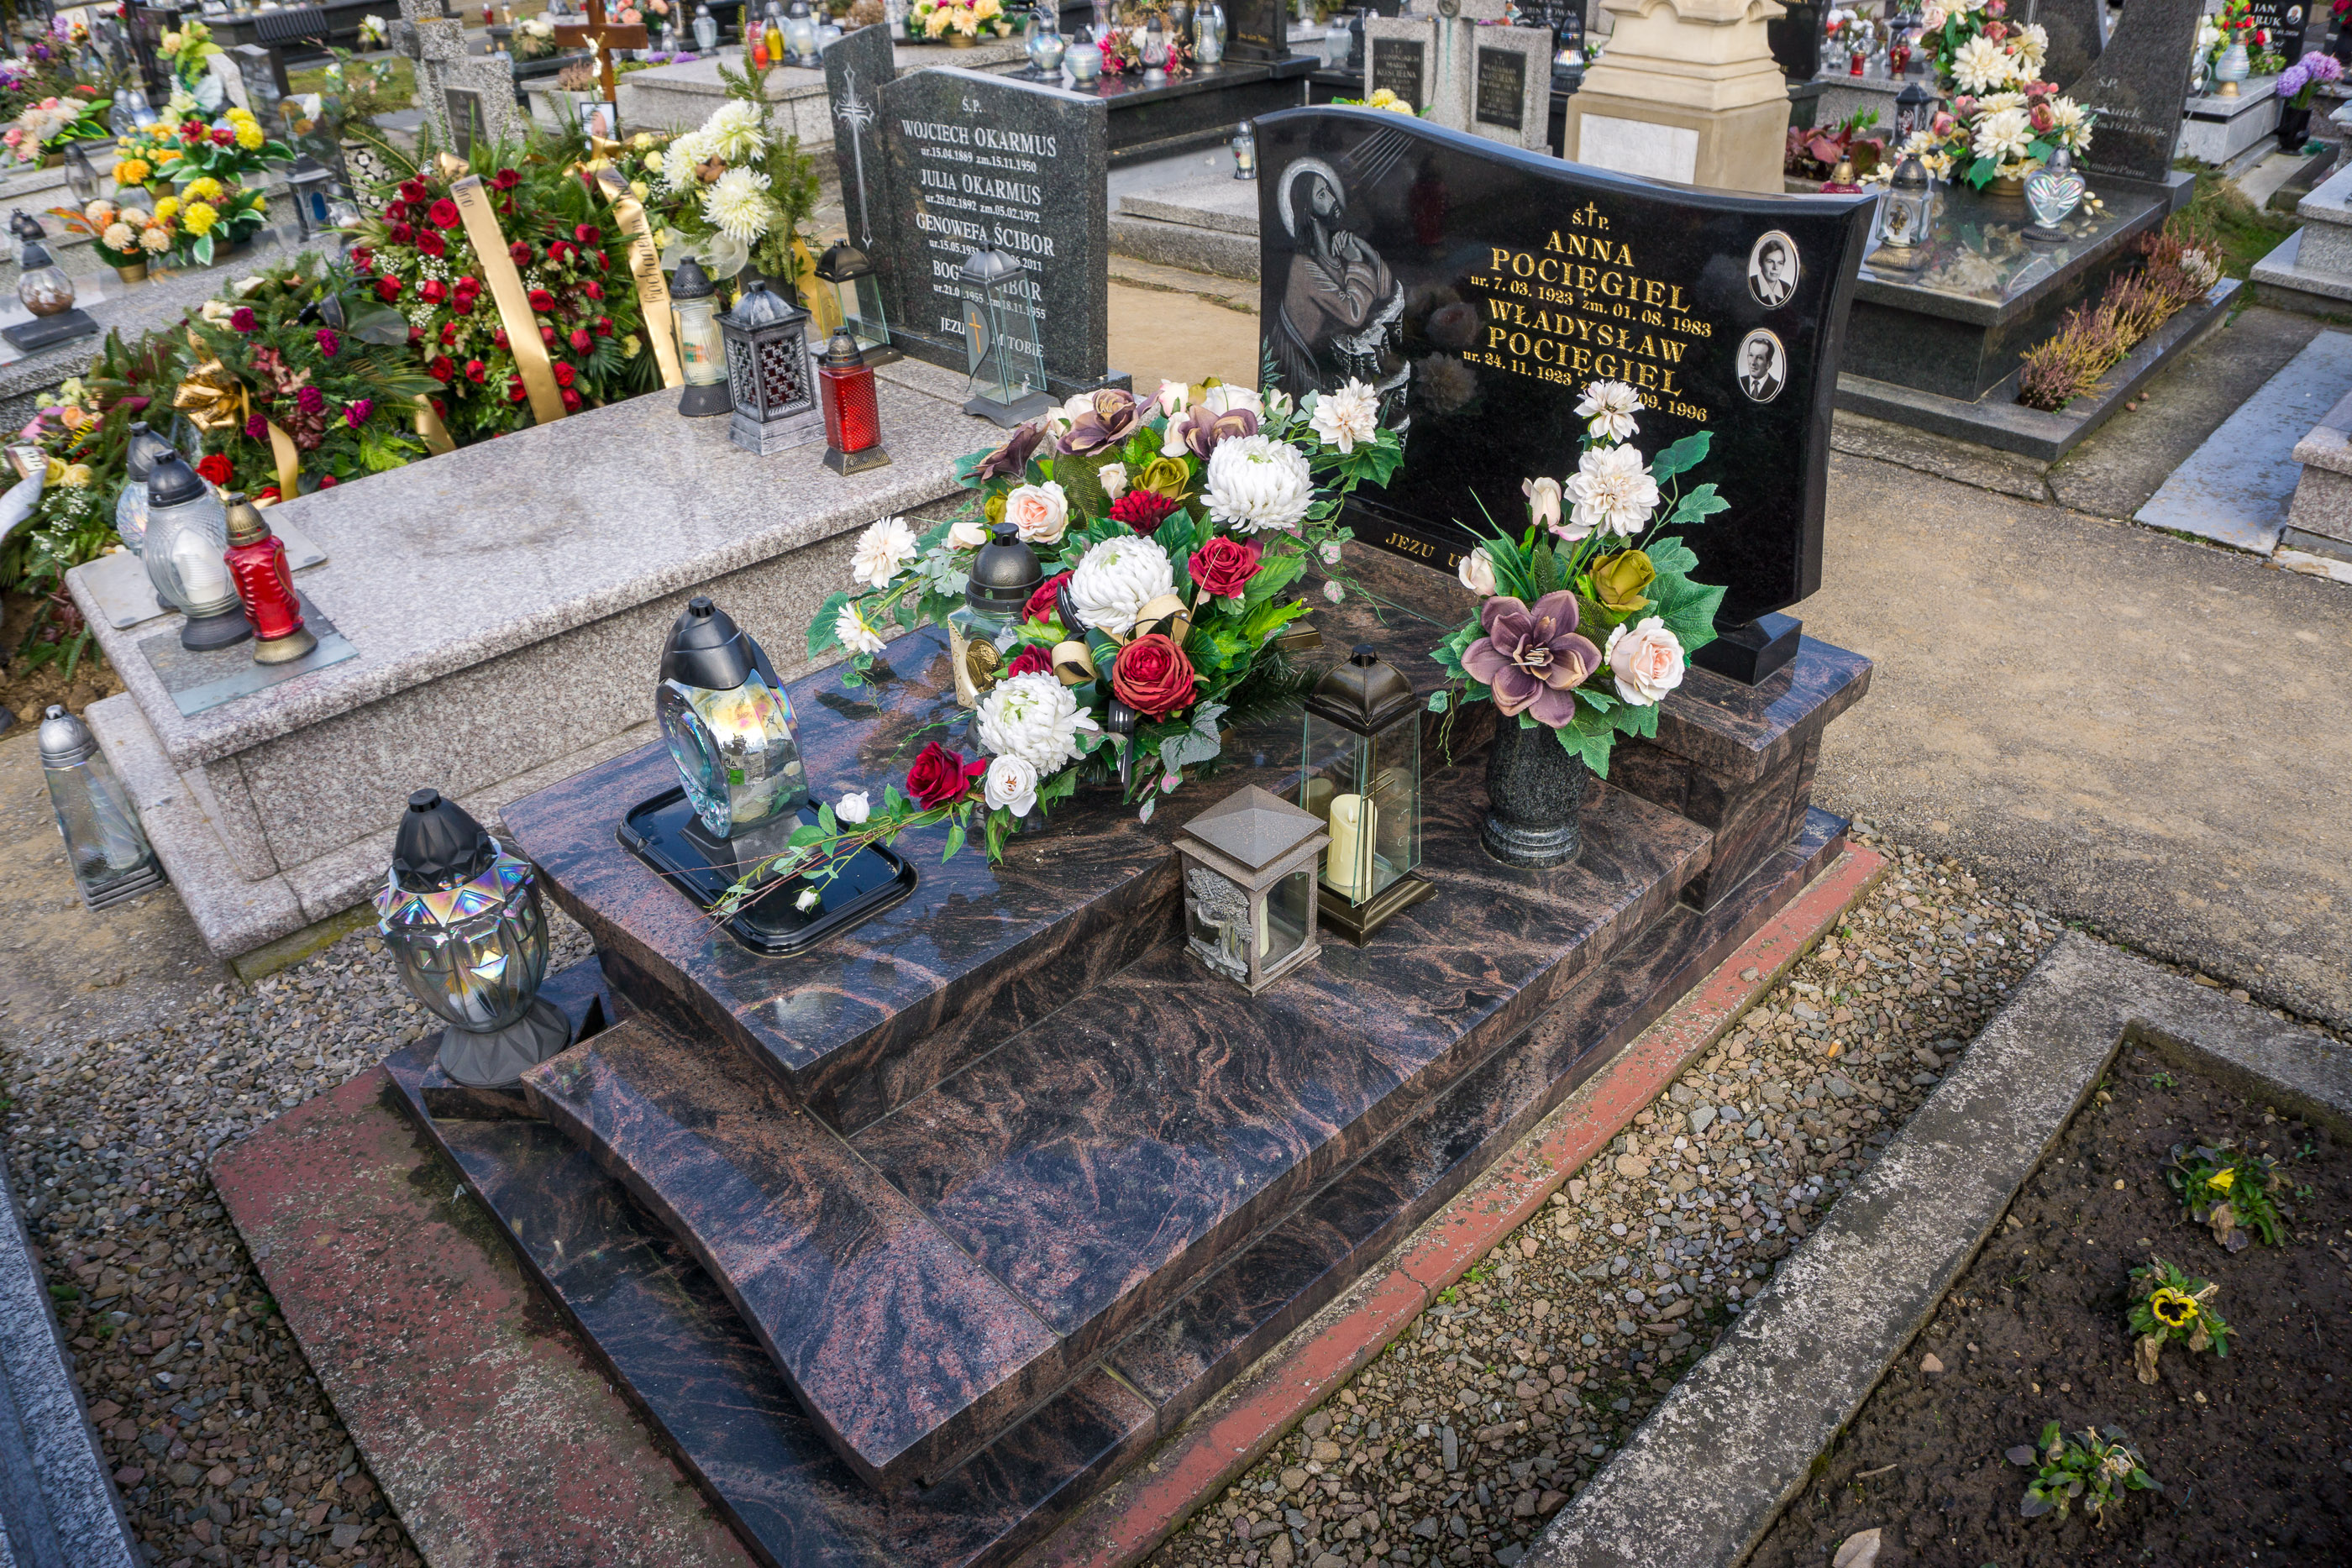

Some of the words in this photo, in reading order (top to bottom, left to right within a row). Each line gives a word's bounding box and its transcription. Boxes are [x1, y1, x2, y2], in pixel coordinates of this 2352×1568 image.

[901, 119, 969, 144] WOJCIECH
[974, 127, 1057, 158] OKARMUS
[921, 146, 973, 162] ur.15.04.1889
[976, 155, 1037, 173] zm.15.11.1950
[921, 169, 958, 191] JULIA
[962, 173, 1041, 205] OKARMUS
[925, 194, 977, 211] ur.25.02.1892
[979, 204, 1041, 223] zm.05.02.1972
[916, 212, 987, 241] GENOWEFA
[994, 221, 1056, 257] ŚCIBOR
[1544, 229, 1635, 268] ANNA
[1490, 247, 1691, 313] POCIĘGIEL
[940, 317, 966, 335] JEZU
[1471, 275, 1489, 287] ur.
[1494, 276, 1506, 291] 7.
[1510, 280, 1532, 297] 03.
[1538, 286, 1574, 306] 1923
[1582, 300, 1608, 314] zm.
[1613, 302, 1636, 321] 01.
[1641, 309, 1666, 328] 08.
[1672, 317, 1712, 338] 1983
[1488, 297, 1688, 363] WŁADYSŁAW
[1487, 325, 1683, 397] POCIĘGIEL
[1463, 350, 1481, 363] ur.
[1484, 352, 1506, 370] 24.
[1511, 359, 1532, 376] 11.
[1536, 366, 1572, 385] 1923
[1668, 400, 1708, 422] 1996
[1386, 532, 1436, 558] JEZU
